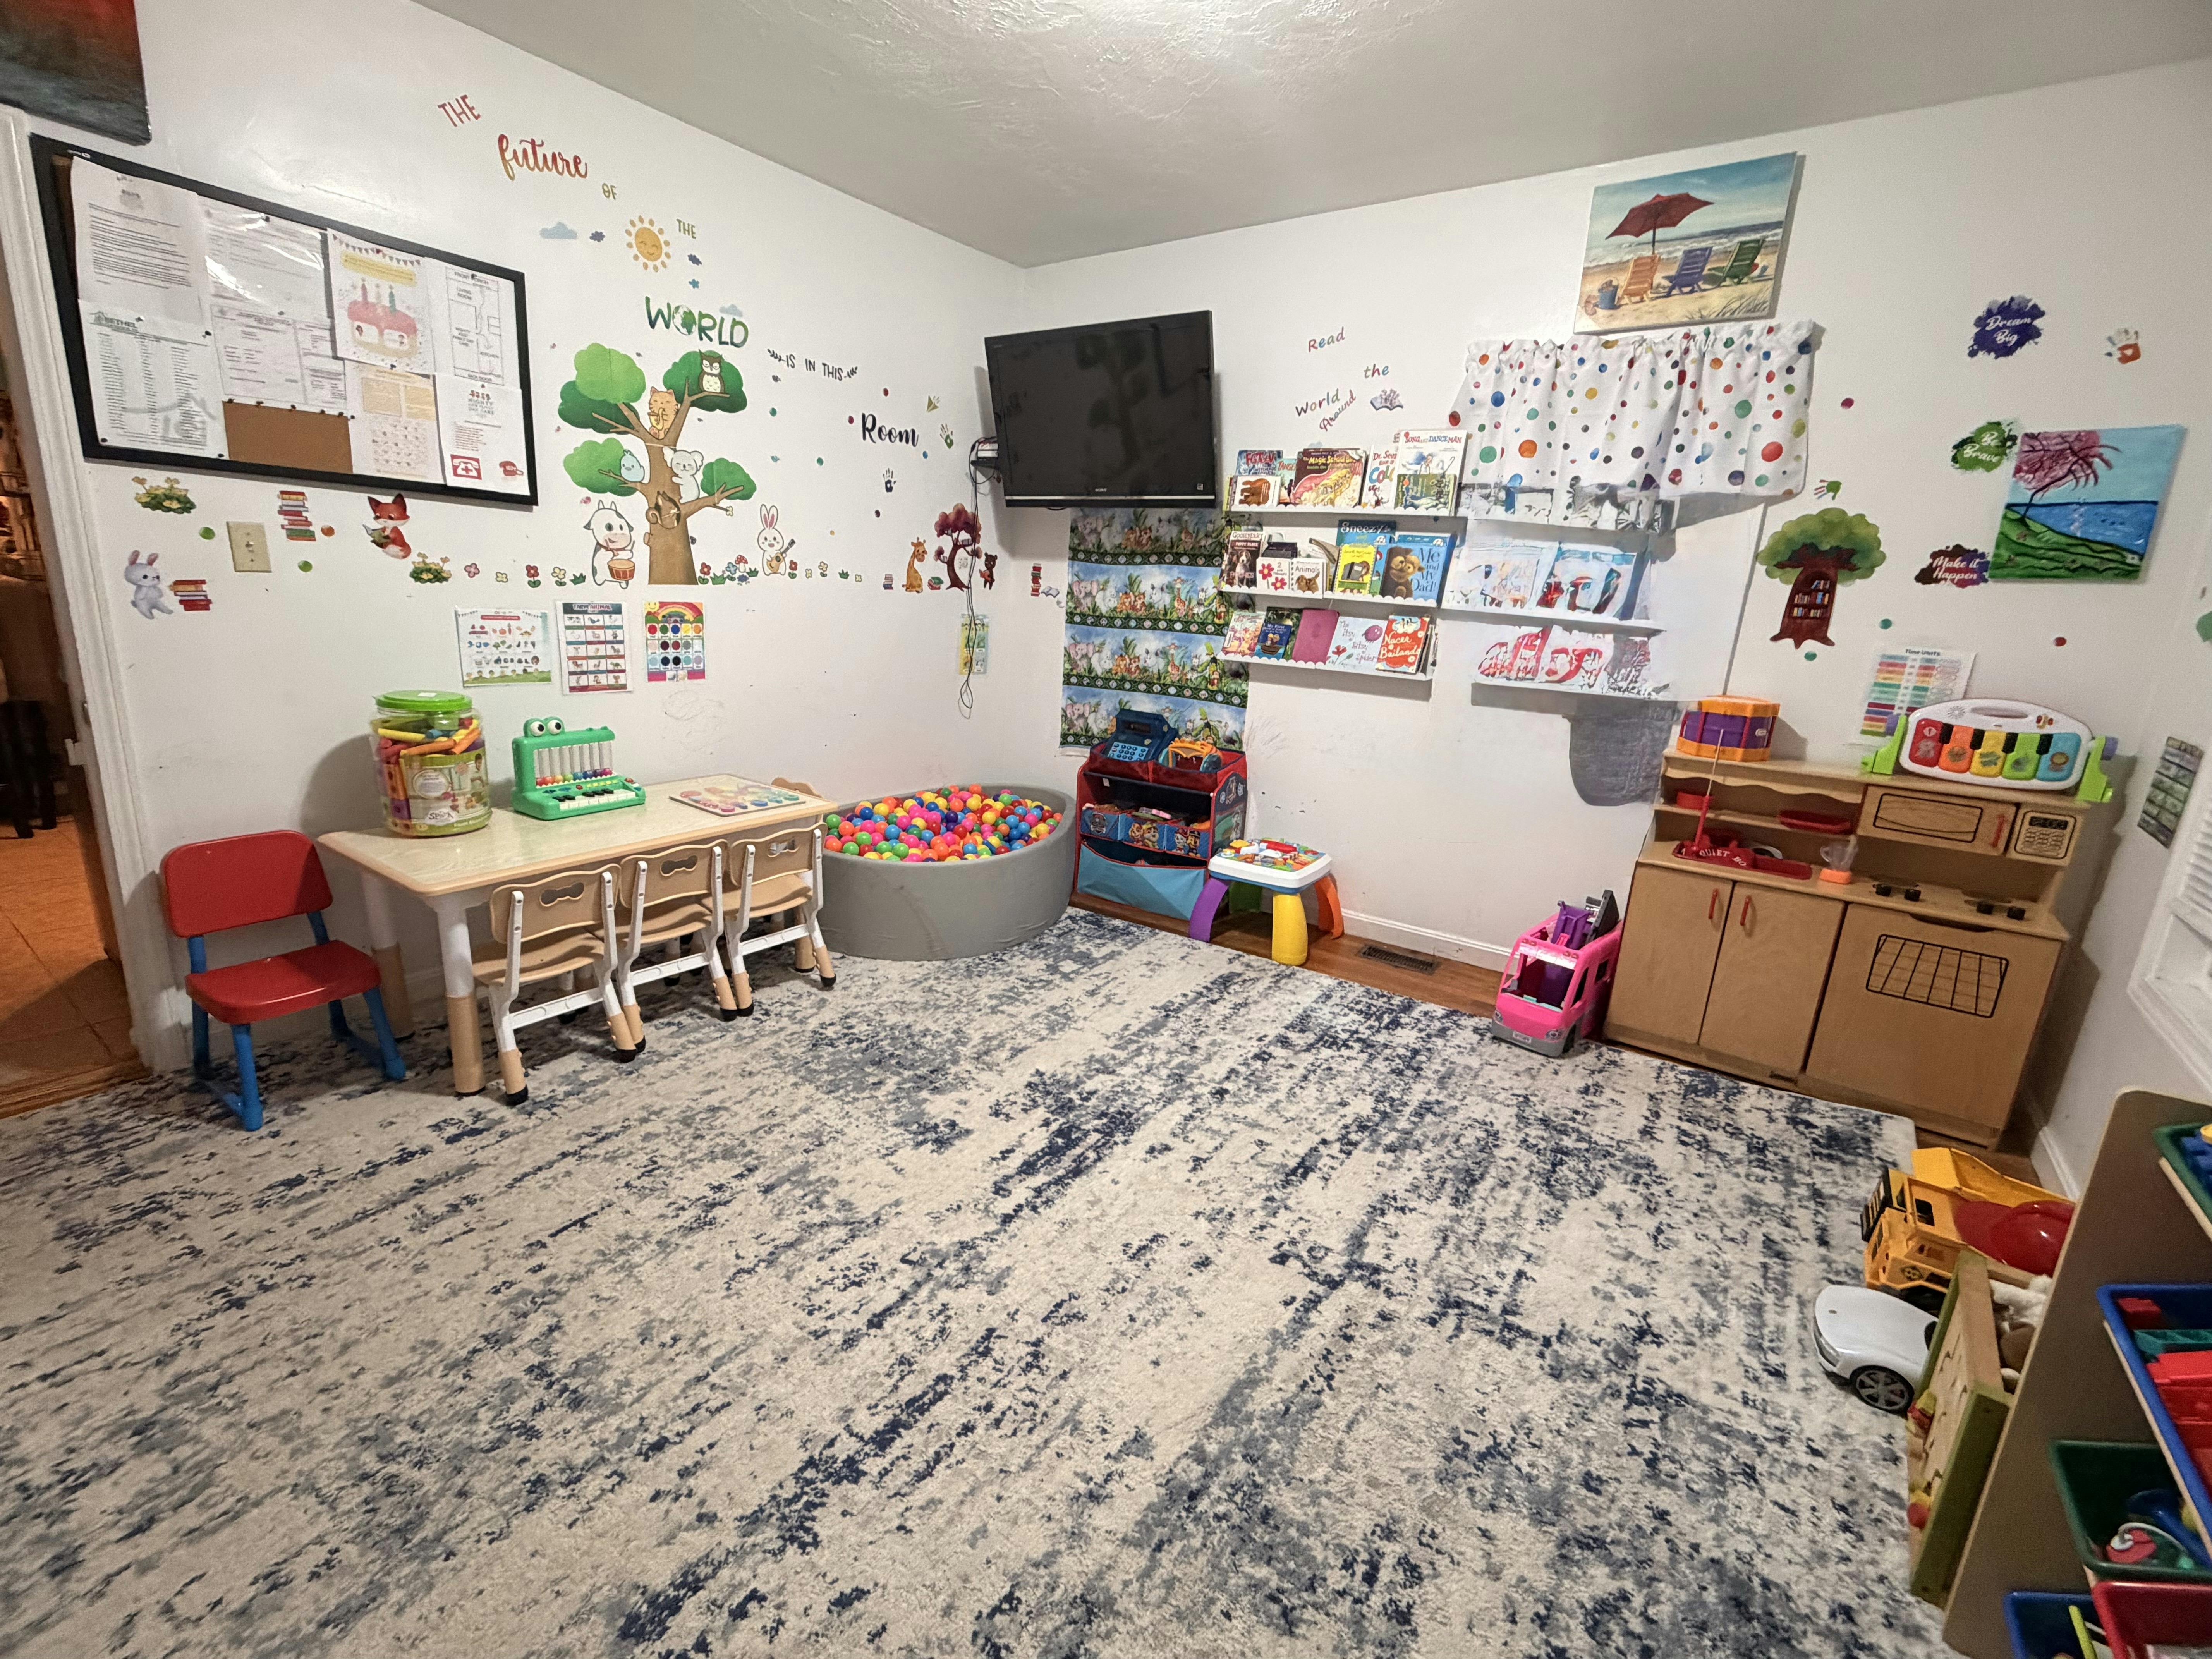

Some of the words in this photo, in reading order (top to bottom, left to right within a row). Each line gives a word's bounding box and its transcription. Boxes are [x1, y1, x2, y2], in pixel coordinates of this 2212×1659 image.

[438, 94, 481, 127] THE
[498, 133, 588, 181] future
[602, 183, 617, 200] OF
[676, 218, 697, 239] THE
[645, 296, 749, 349] WORLD
[1985, 315, 2032, 331] Dream
[1308, 326, 1345, 353] Read
[1994, 329, 2019, 346] Big
[785, 354, 795, 369] IS
[805, 358, 816, 372] IN
[821, 362, 843, 381] THIS
[1364, 363, 1389, 379] the
[1295, 388, 1341, 417] World
[1319, 388, 1356, 432] Around
[861, 412, 919, 447] Room
[1980, 431, 2001, 447] Be
[1308, 455, 1327, 465] Magic
[1373, 452, 1382, 461] Dr.
[1963, 443, 2000, 463] Brave
[1340, 521, 1385, 534] Sneezy
[1420, 547, 1440, 563] Me
[1932, 556, 1966, 570] Make
[1969, 556, 1980, 568] it
[1932, 569, 1978, 581] Happen
[1411, 578, 1437, 592] Dad!
[1382, 631, 1412, 645] Nacer
[1378, 644, 1422, 659] Bailando
[1699, 848, 1731, 857] QUIET
